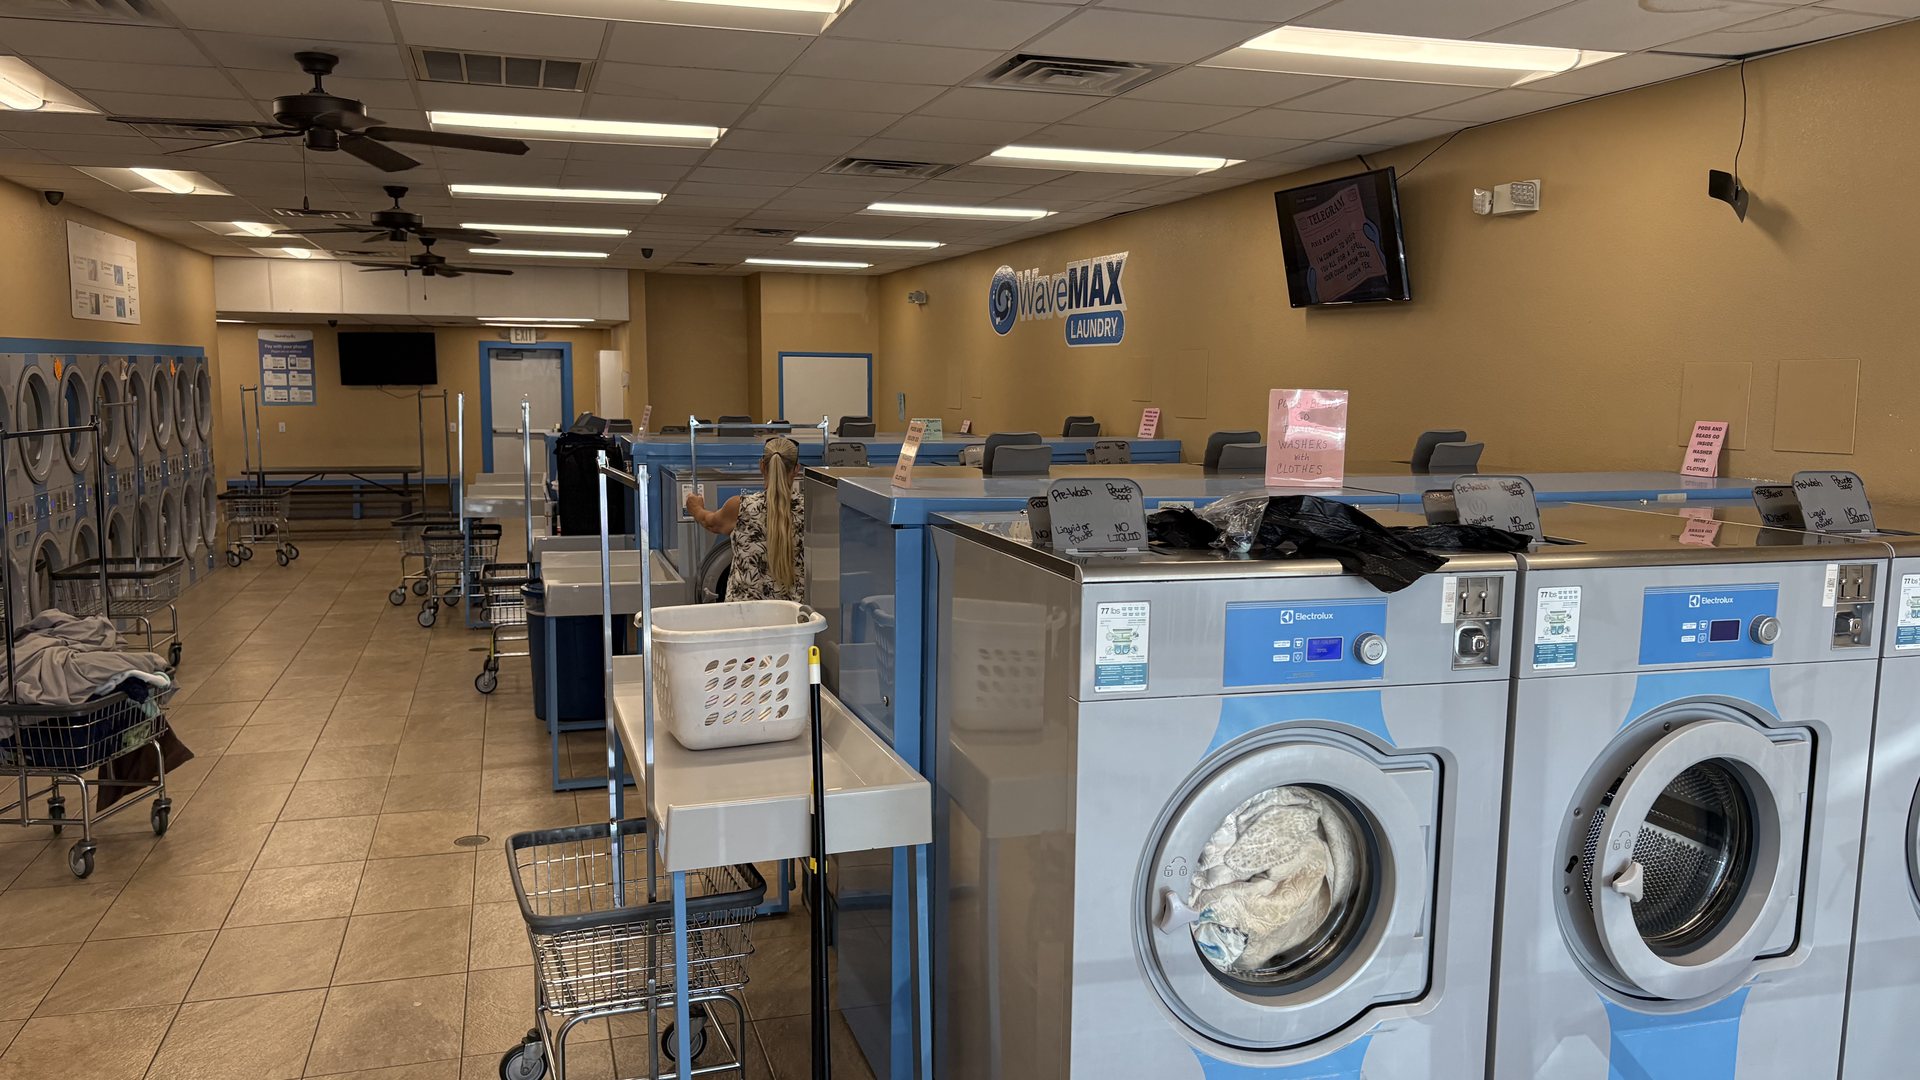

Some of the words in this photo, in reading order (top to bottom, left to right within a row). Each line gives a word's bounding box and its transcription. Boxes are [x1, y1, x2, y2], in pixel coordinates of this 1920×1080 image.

[1306, 195, 1345, 226] TELEGRAM
[1016, 256, 1124, 317] WaveMAX
[1070, 316, 1118, 338] LAUNDRY
[514, 329, 532, 341] EXIT
[1278, 398, 1301, 409] POS
[1278, 439, 1327, 450] WASHERS
[1276, 465, 1322, 475] CLOTHES
[1051, 486, 1092, 502] Pre-Wash
[1509, 489, 1525, 497] Soap
[1510, 516, 1521, 524] NO
[1081, 523, 1090, 531] or
[1114, 522, 1129, 533] NO
[1035, 530, 1049, 539] NO
[1107, 532, 1141, 542] LIQUID
[1296, 612, 1333, 620] Electrolux
